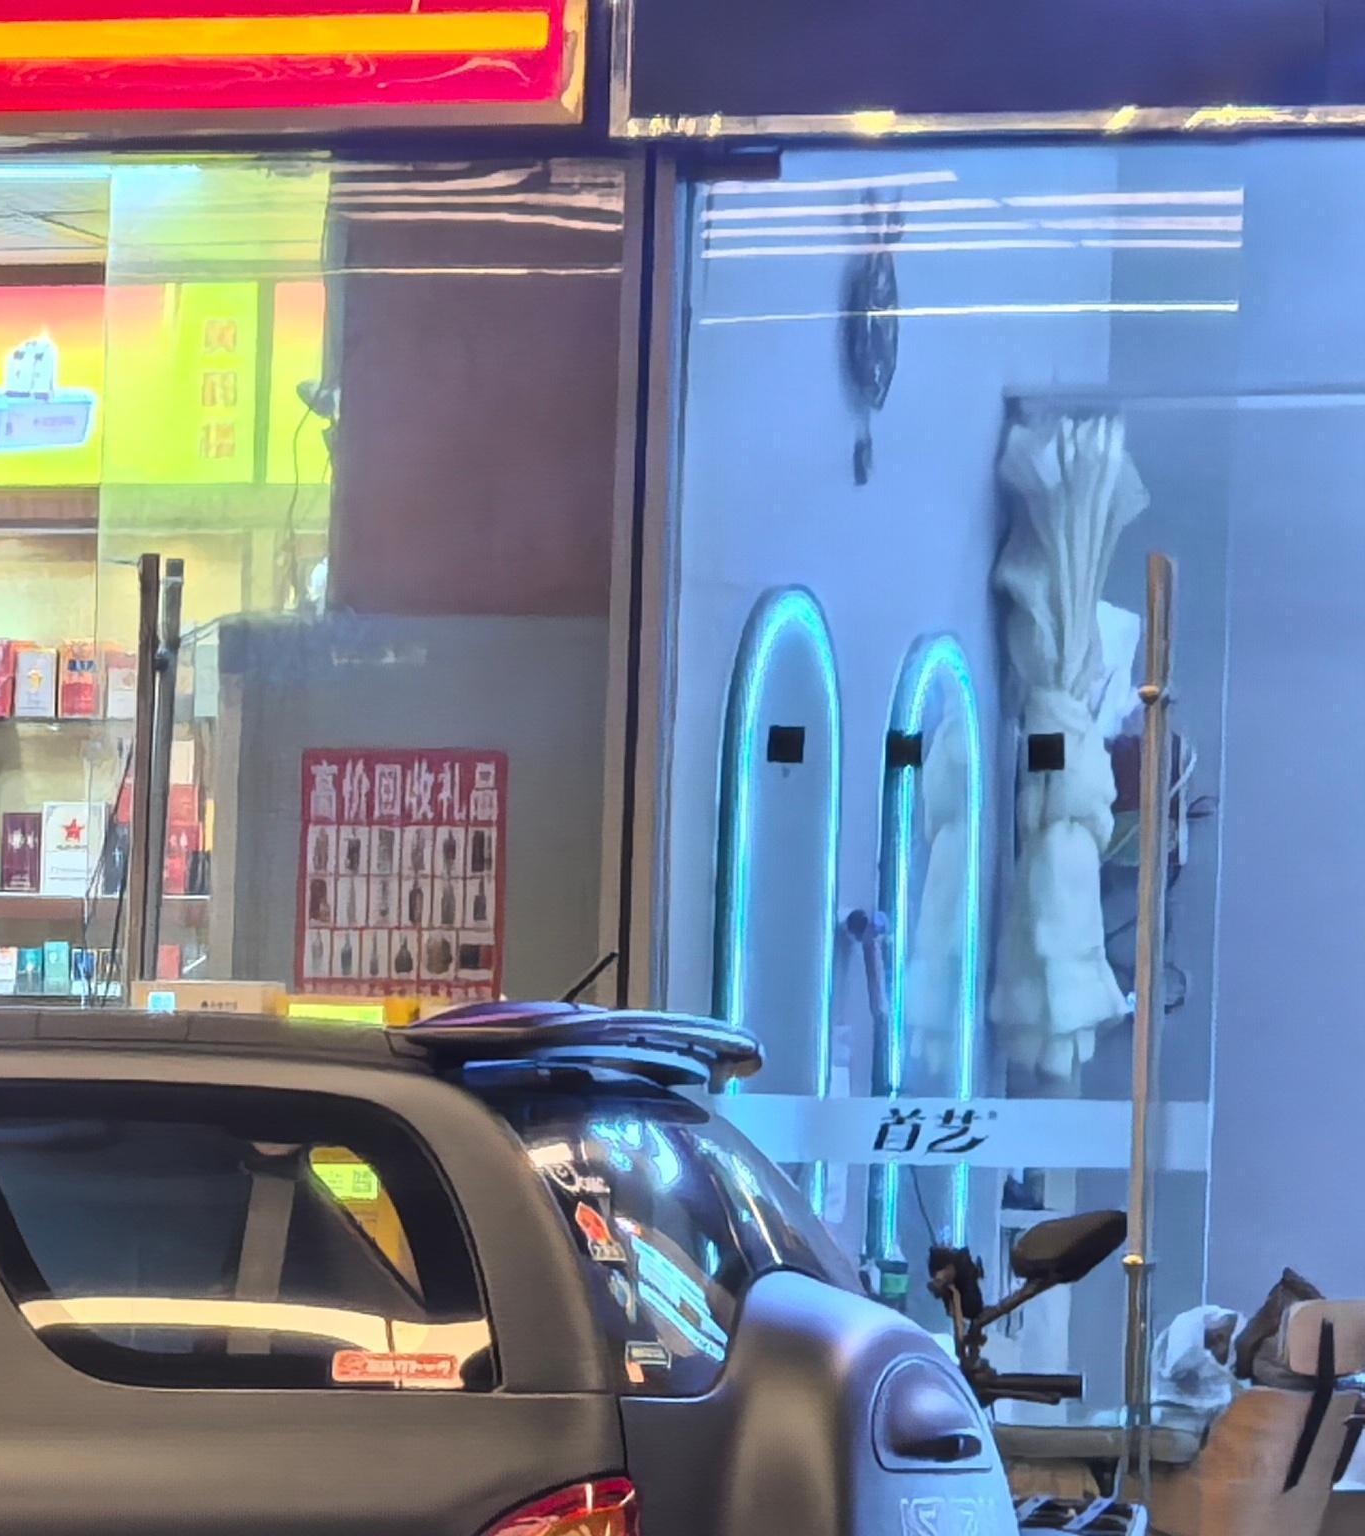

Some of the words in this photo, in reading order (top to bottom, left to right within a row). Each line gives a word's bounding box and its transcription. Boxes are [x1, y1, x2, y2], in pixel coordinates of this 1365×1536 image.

[310, 757, 498, 824] 高价回收礼品
[872, 1107, 988, 1156] 首艺
